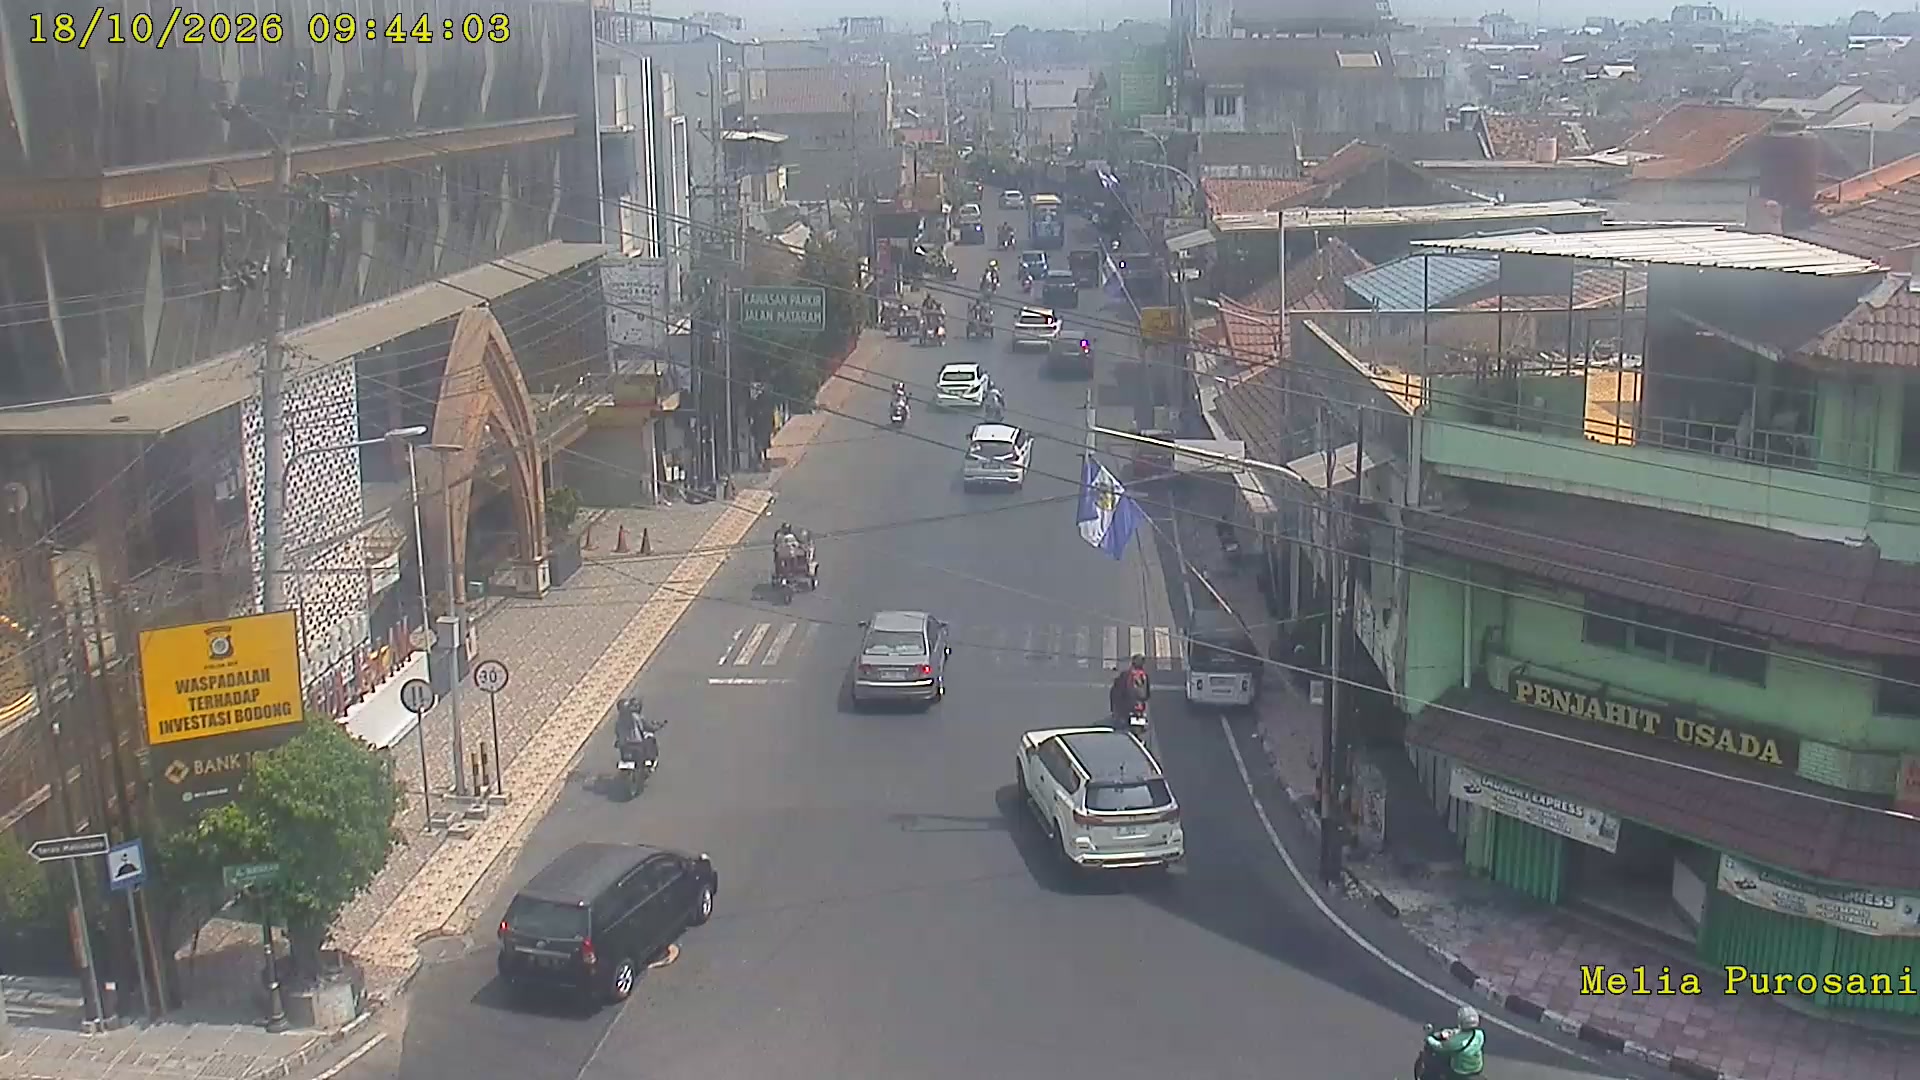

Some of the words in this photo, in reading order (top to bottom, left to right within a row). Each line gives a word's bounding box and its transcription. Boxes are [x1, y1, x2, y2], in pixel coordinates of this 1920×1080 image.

[743, 310, 773, 321] JALAN
[777, 311, 821, 324] MATARAM
[175, 668, 271, 694] WASPADALAH
[479, 669, 497, 683] 30
[188, 688, 260, 712] TERHADAP
[159, 712, 231, 735] INVESTASI
[235, 701, 292, 724] BODONG
[1515, 680, 1661, 735] PENJAHIT
[1674, 718, 1783, 764] USADA
[194, 753, 241, 776] BANK
[1531, 794, 1584, 818] EXPRESS
